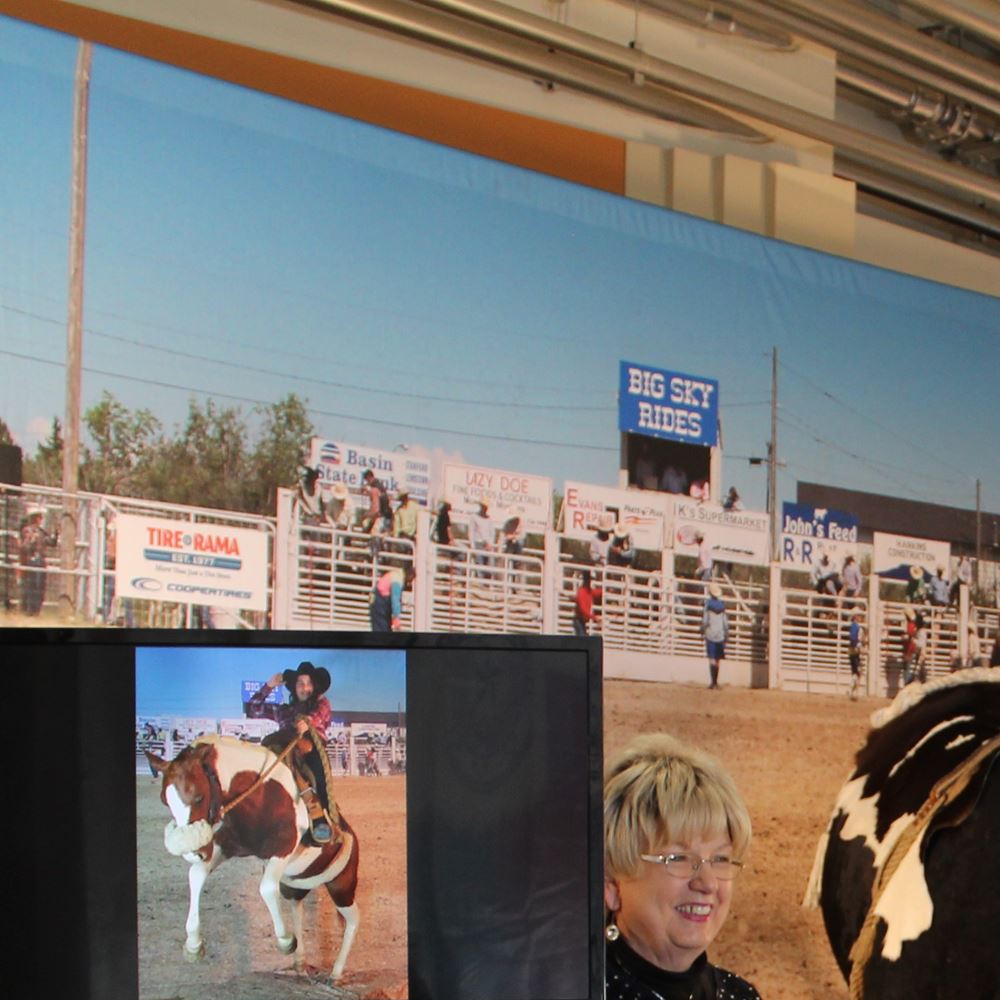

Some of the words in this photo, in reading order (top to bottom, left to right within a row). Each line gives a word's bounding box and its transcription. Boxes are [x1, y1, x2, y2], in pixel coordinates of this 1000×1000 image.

[628, 367, 665, 399] BIG
[670, 377, 714, 409] SKY
[638, 401, 702, 437] RIDES
[316, 464, 357, 485] State
[346, 449, 393, 472] Basin
[500, 475, 528, 494] DOE
[147, 527, 183, 549] TIRE
[193, 533, 240, 556] RAMA
[785, 515, 825, 538] John's
[828, 521, 858, 544] Feed
